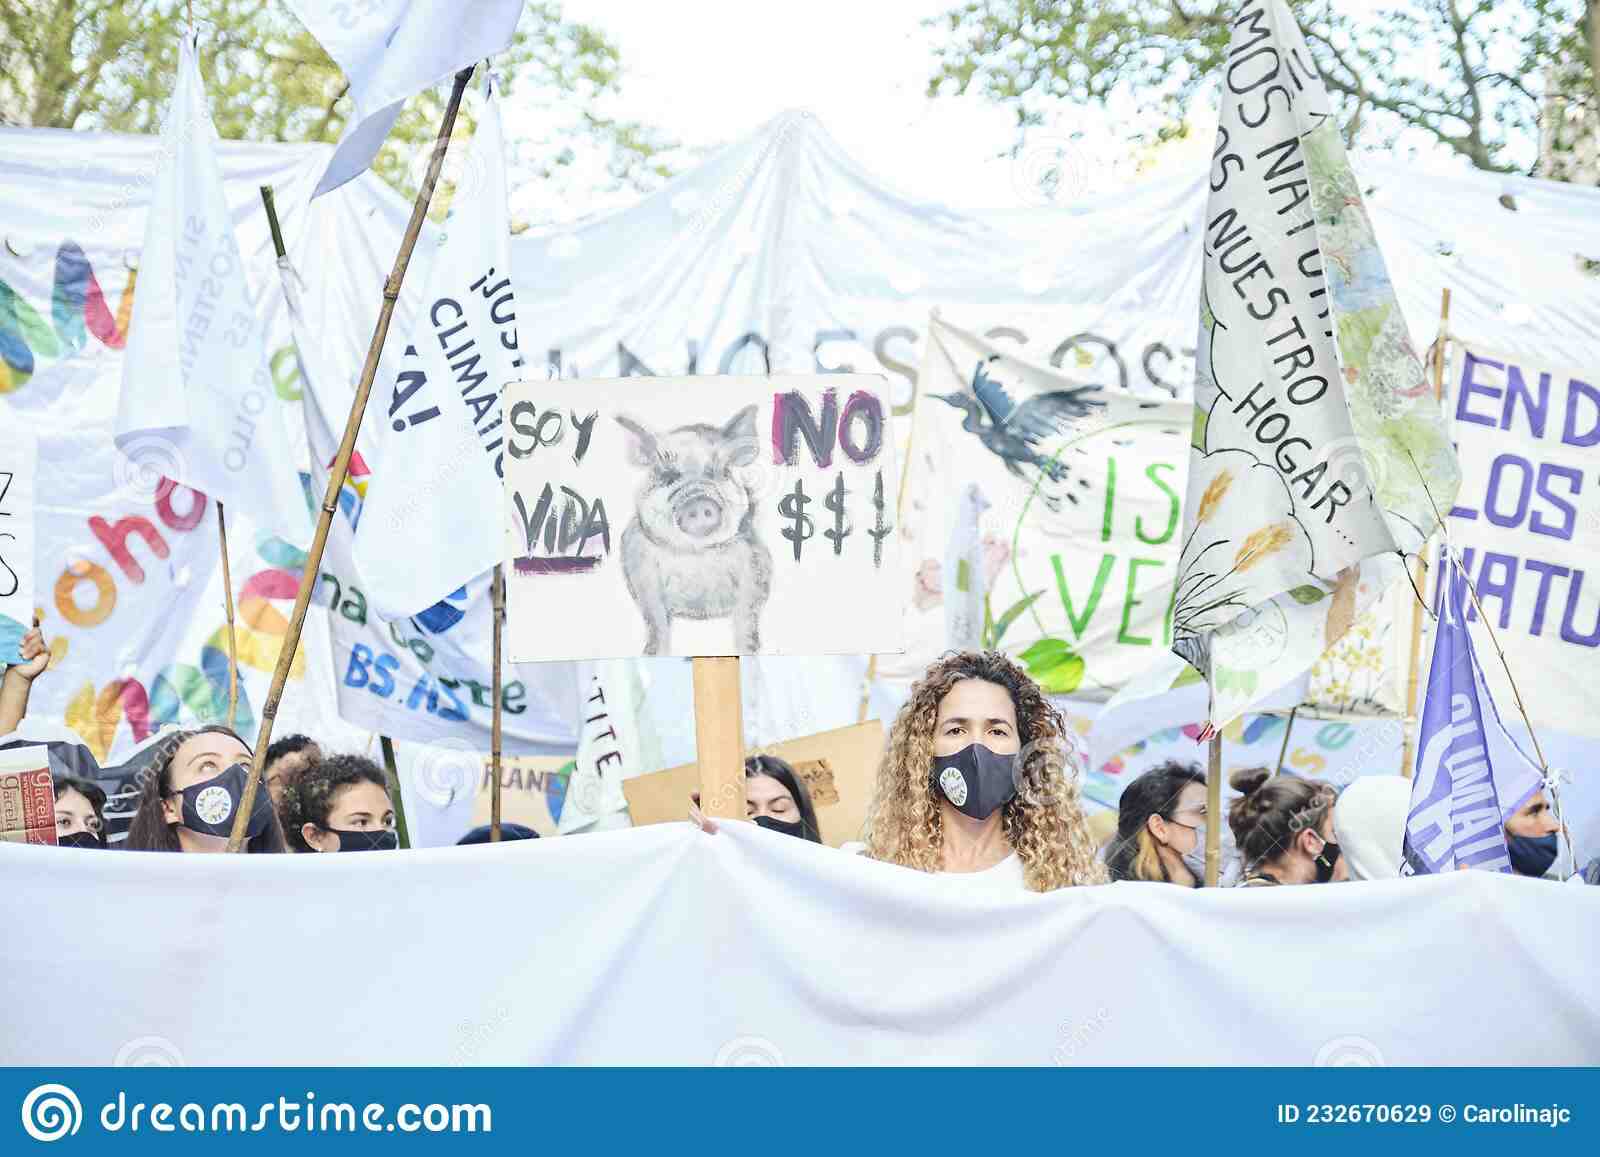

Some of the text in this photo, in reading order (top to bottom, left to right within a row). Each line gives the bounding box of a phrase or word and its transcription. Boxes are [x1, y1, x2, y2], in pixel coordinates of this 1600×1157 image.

[1208, 208, 1329, 405] NUESTRO
[508, 400, 598, 465] SOY
[772, 387, 885, 468] NO
[512, 482, 611, 560] VIDA
